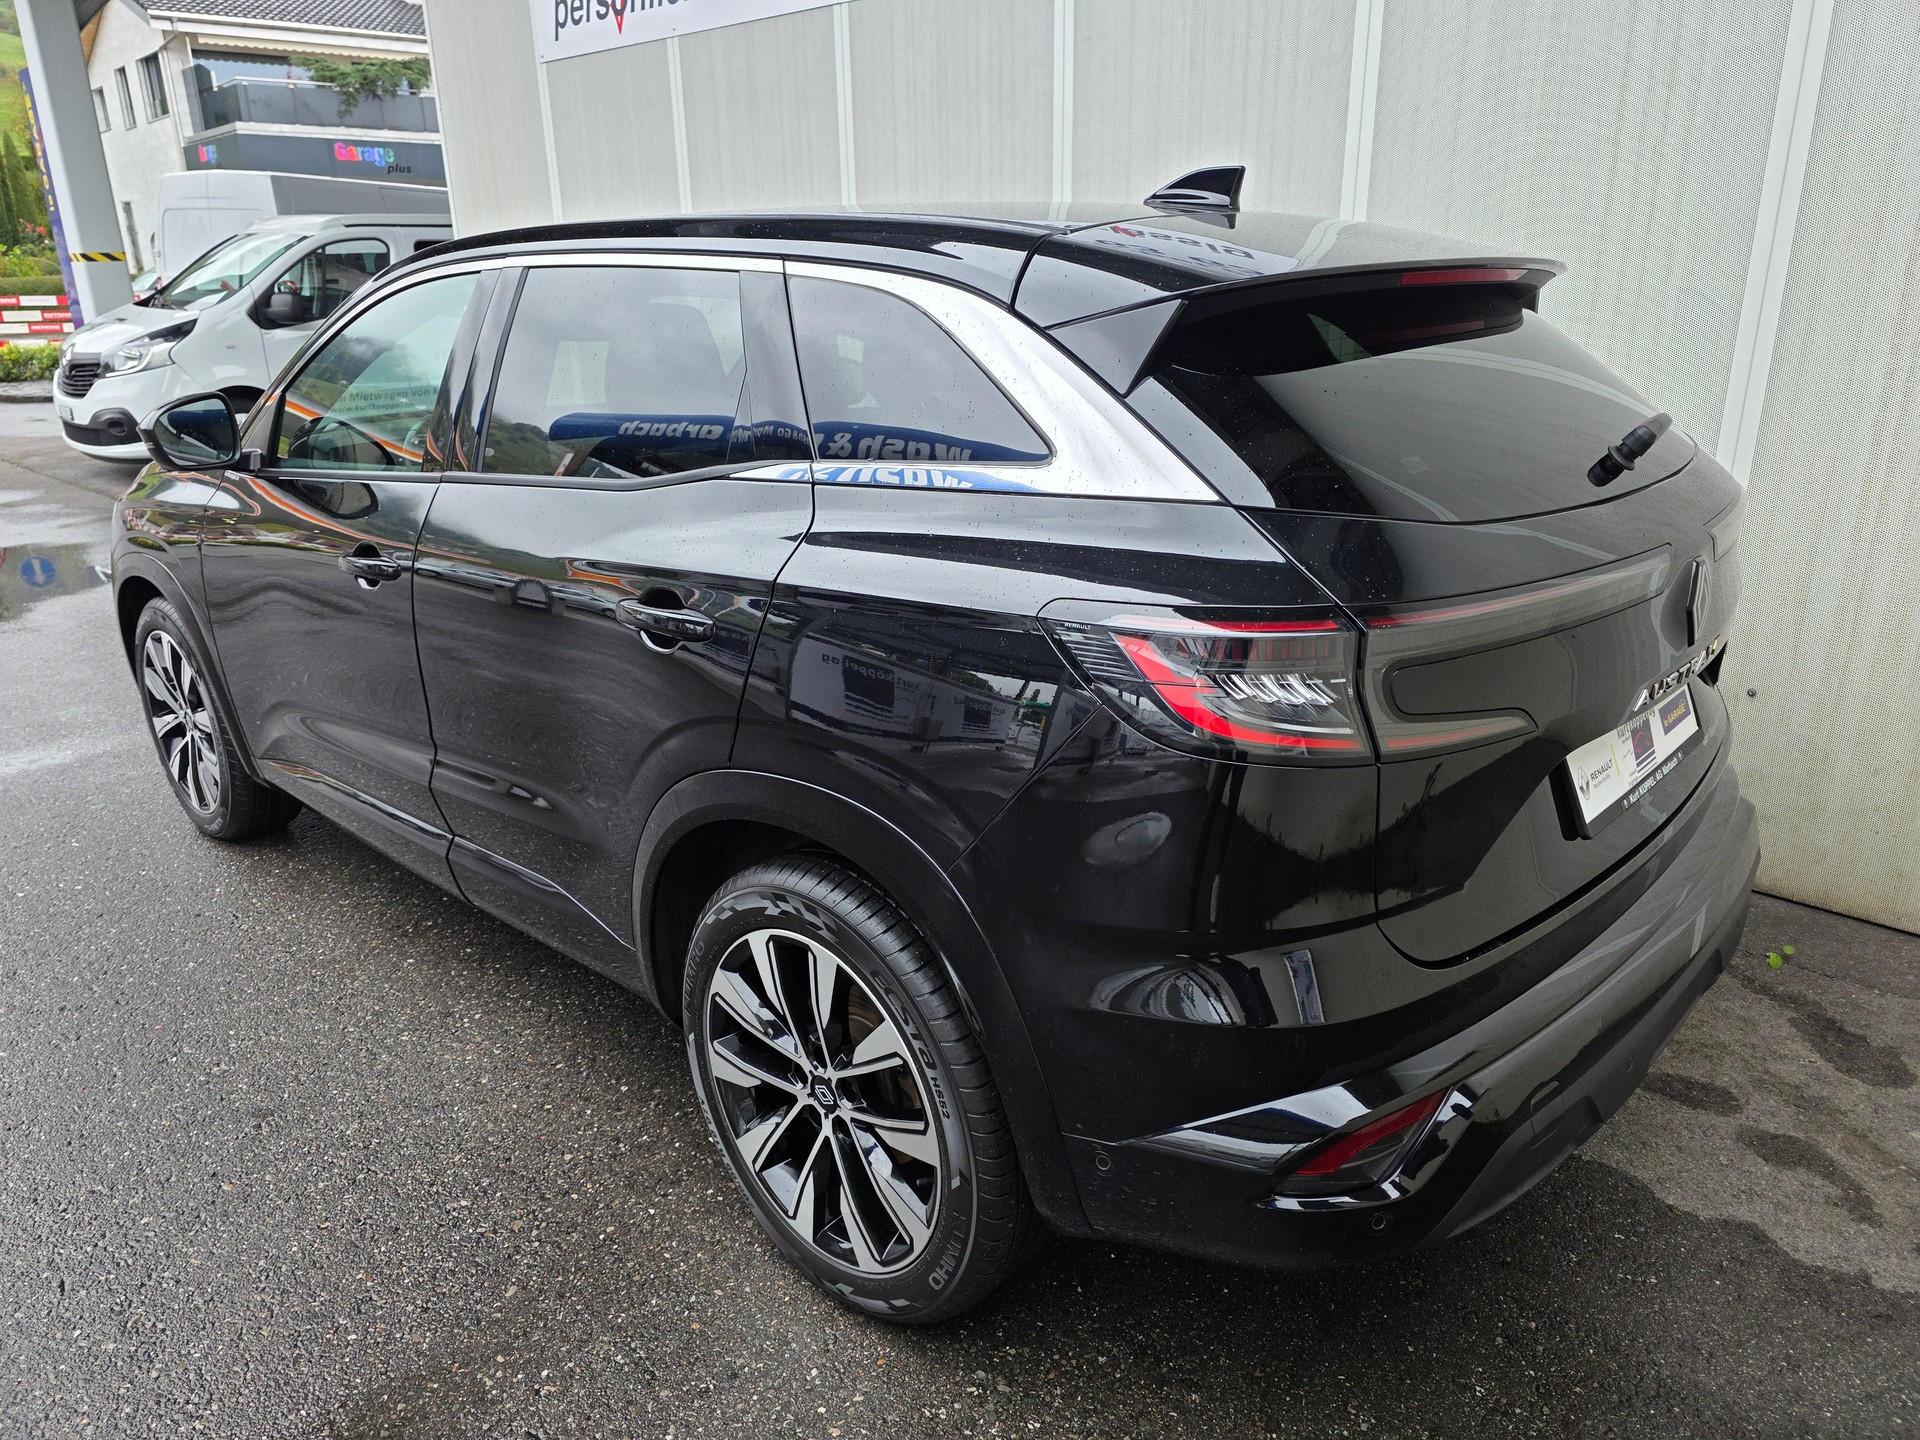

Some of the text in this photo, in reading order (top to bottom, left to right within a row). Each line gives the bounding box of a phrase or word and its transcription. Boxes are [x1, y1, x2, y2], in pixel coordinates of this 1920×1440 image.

[333, 142, 395, 168] Garage
[387, 163, 412, 174] plus
[1064, 622, 1092, 630] RENAULT
[1590, 758, 1614, 782] RENAULT
[930, 1076, 950, 1120] HS52
